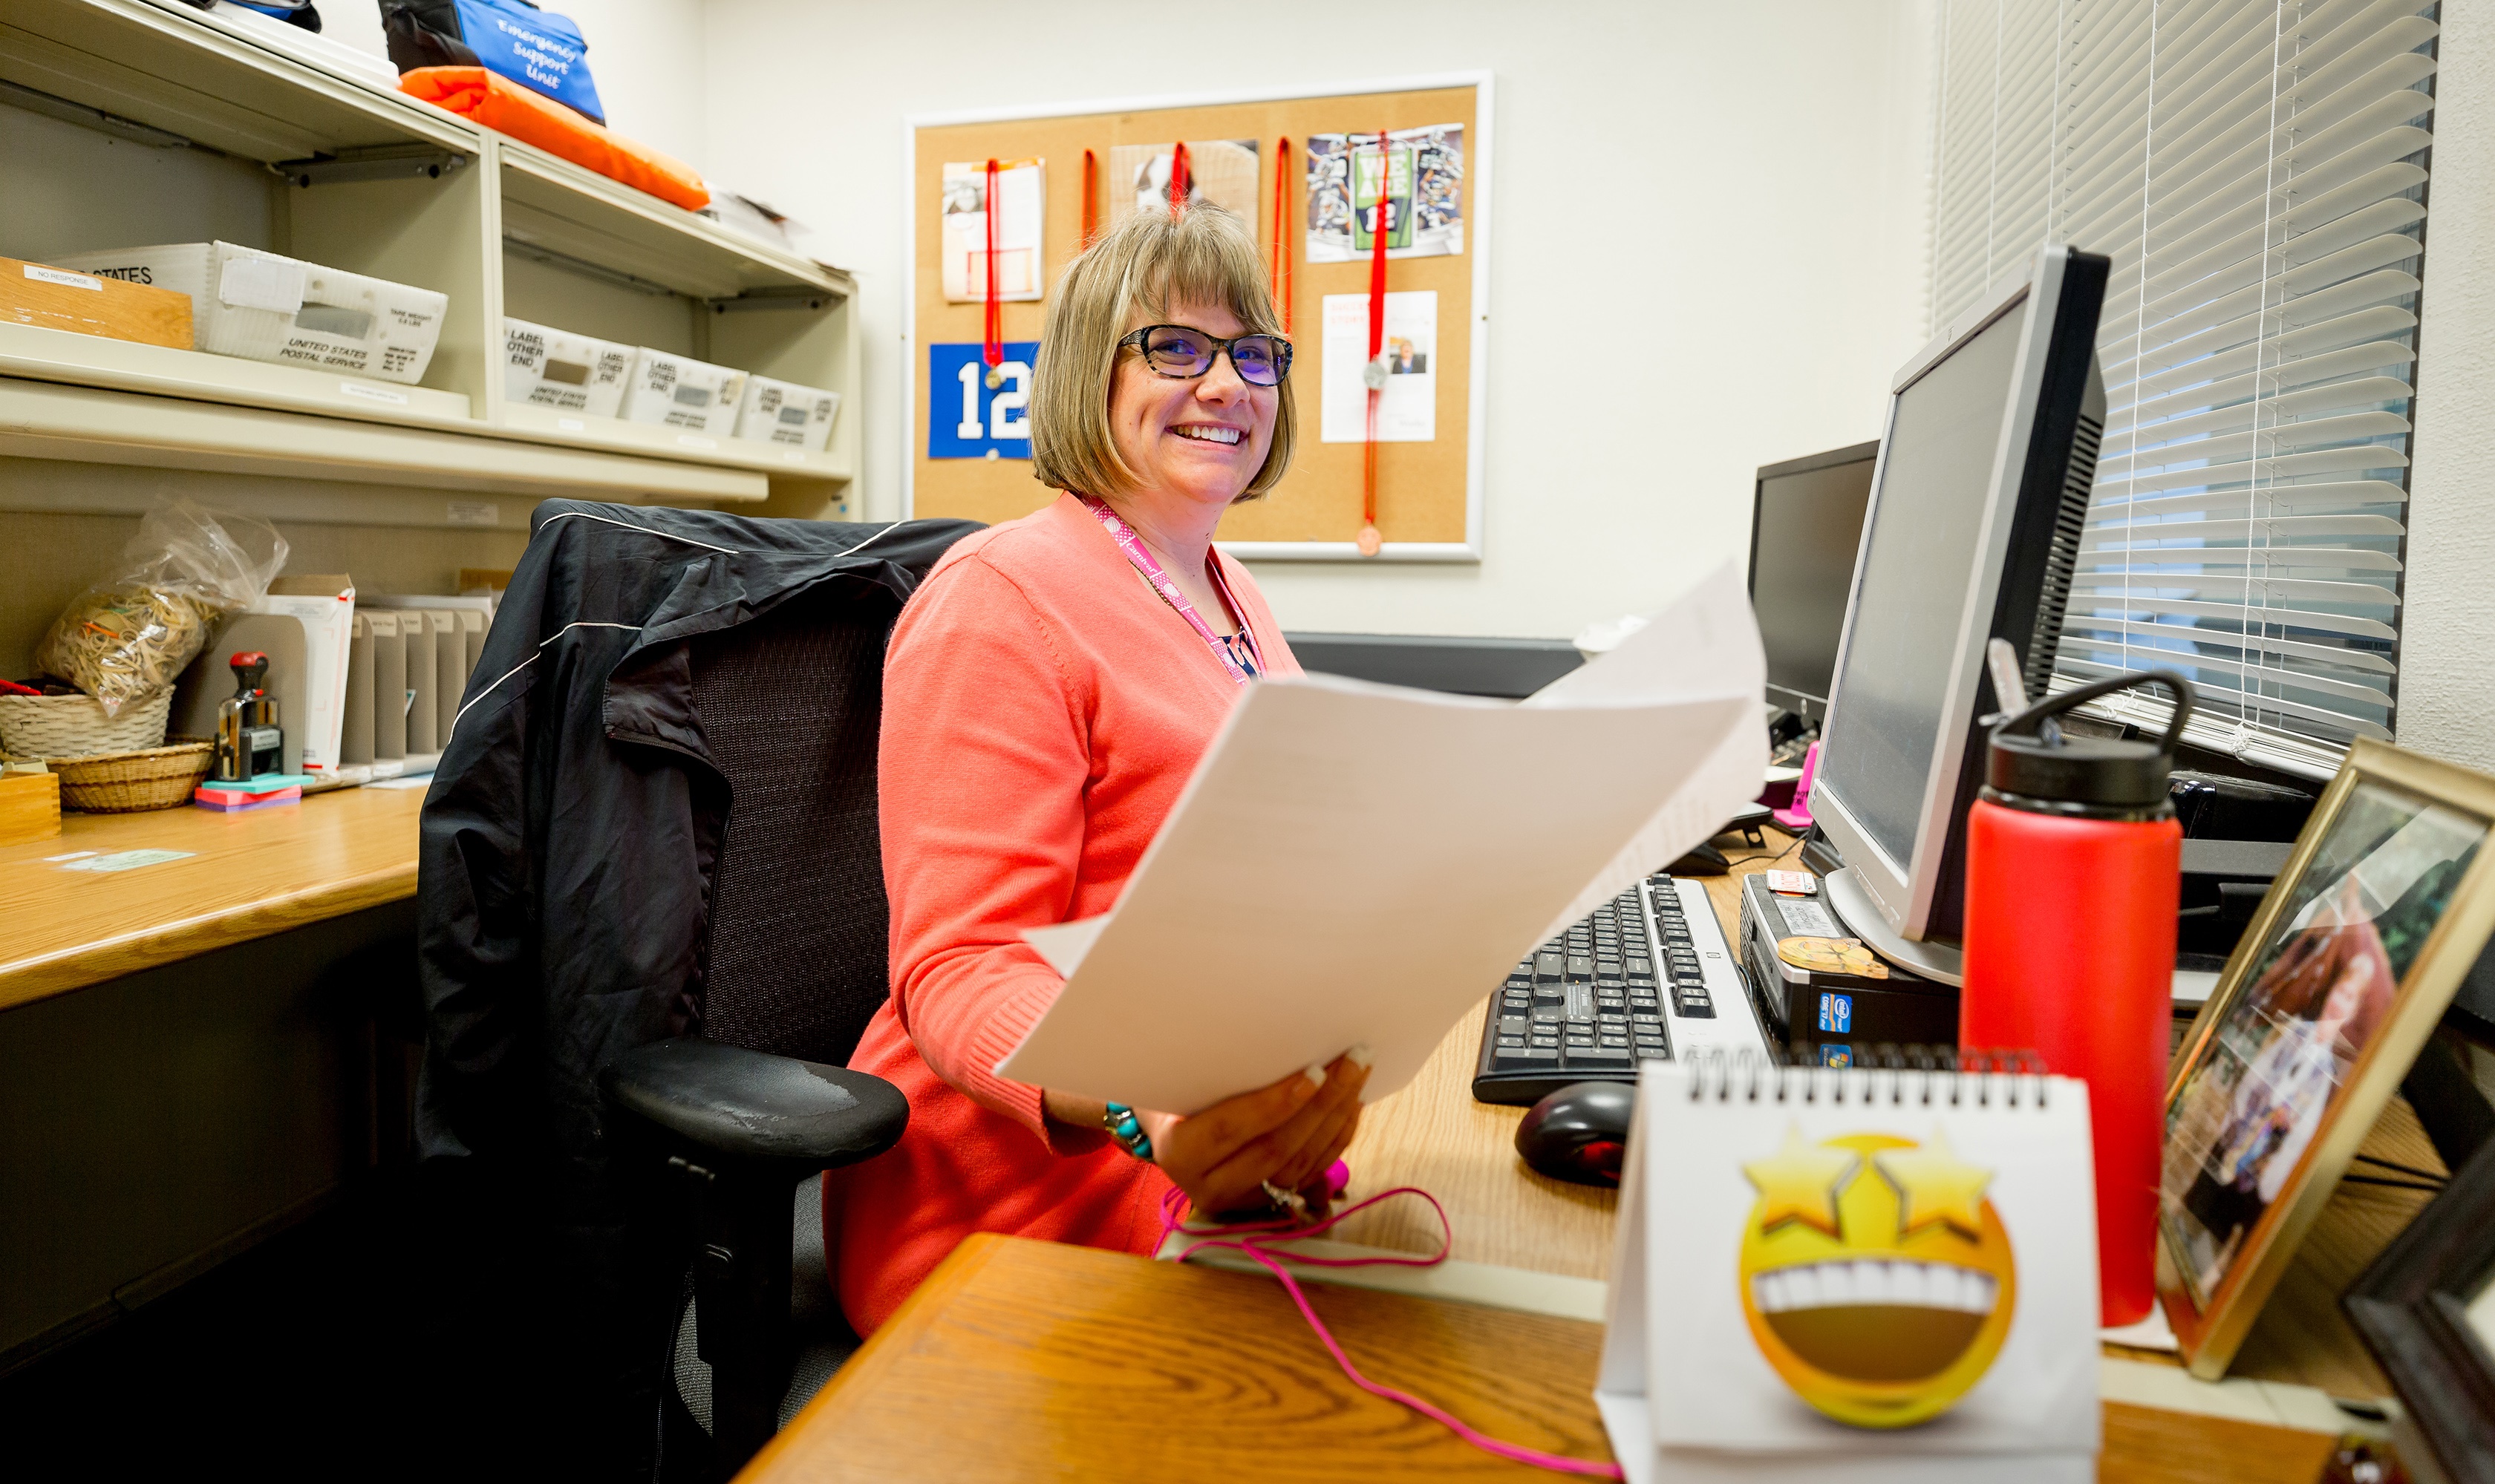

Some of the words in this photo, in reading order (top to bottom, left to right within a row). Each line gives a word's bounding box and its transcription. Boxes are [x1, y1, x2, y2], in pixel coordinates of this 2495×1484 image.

[497, 18, 576, 62] Emergency
[513, 41, 570, 74] Support
[526, 63, 561, 89] Unit
[1359, 154, 1407, 177] WE
[50, 274, 88, 285] RESPONSE
[510, 329, 545, 345] LABEL
[288, 338, 329, 353] UNITED
[329, 345, 368, 360] STATES
[507, 341, 544, 357] OTHER
[601, 350, 624, 362] LABEL
[279, 347, 320, 363] POSTAL
[323, 355, 368, 371] SERVICE
[510, 354, 534, 367] END
[597, 360, 623, 374] OTHER
[650, 360, 676, 372] LABEL
[599, 373, 616, 383] END
[647, 370, 676, 383] OTHER
[957, 361, 1034, 439] 12
